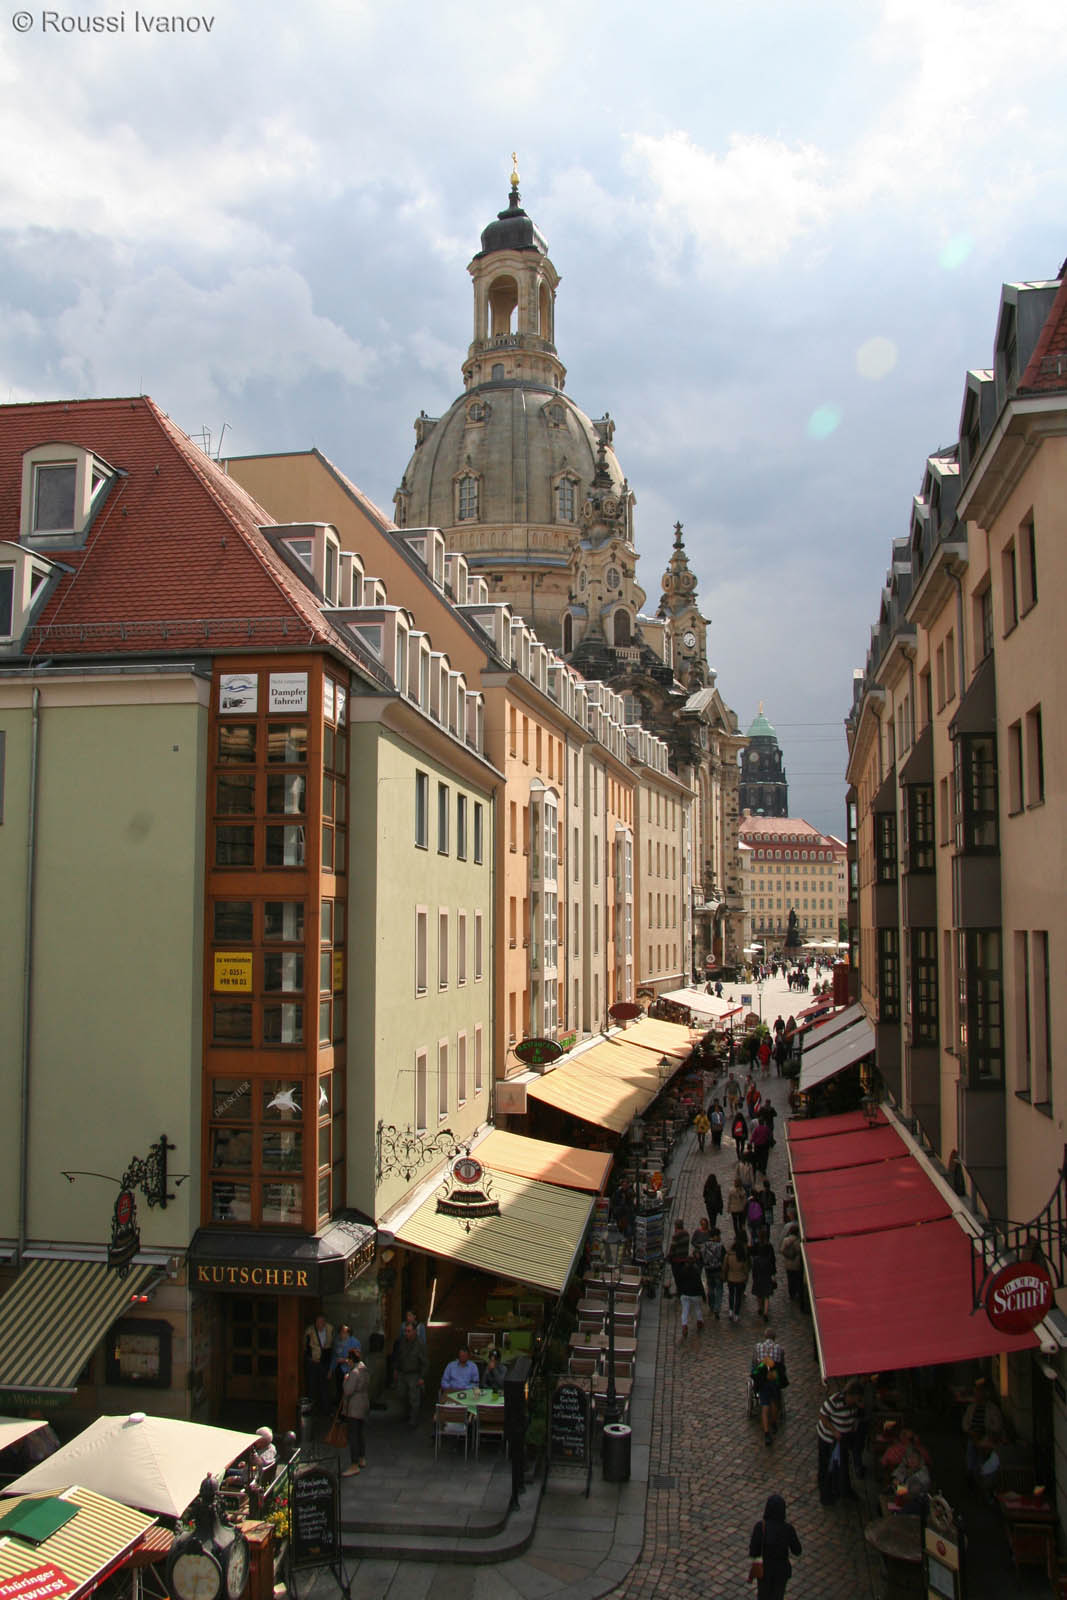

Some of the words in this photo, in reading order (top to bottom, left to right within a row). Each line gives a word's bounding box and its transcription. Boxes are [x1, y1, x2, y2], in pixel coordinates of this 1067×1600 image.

[271, 688, 307, 697] Dampfer
[274, 697, 303, 705] fahren!
[197, 1265, 308, 1287] KUTSCHER
[0, 1570, 54, 1595] Thüringer
